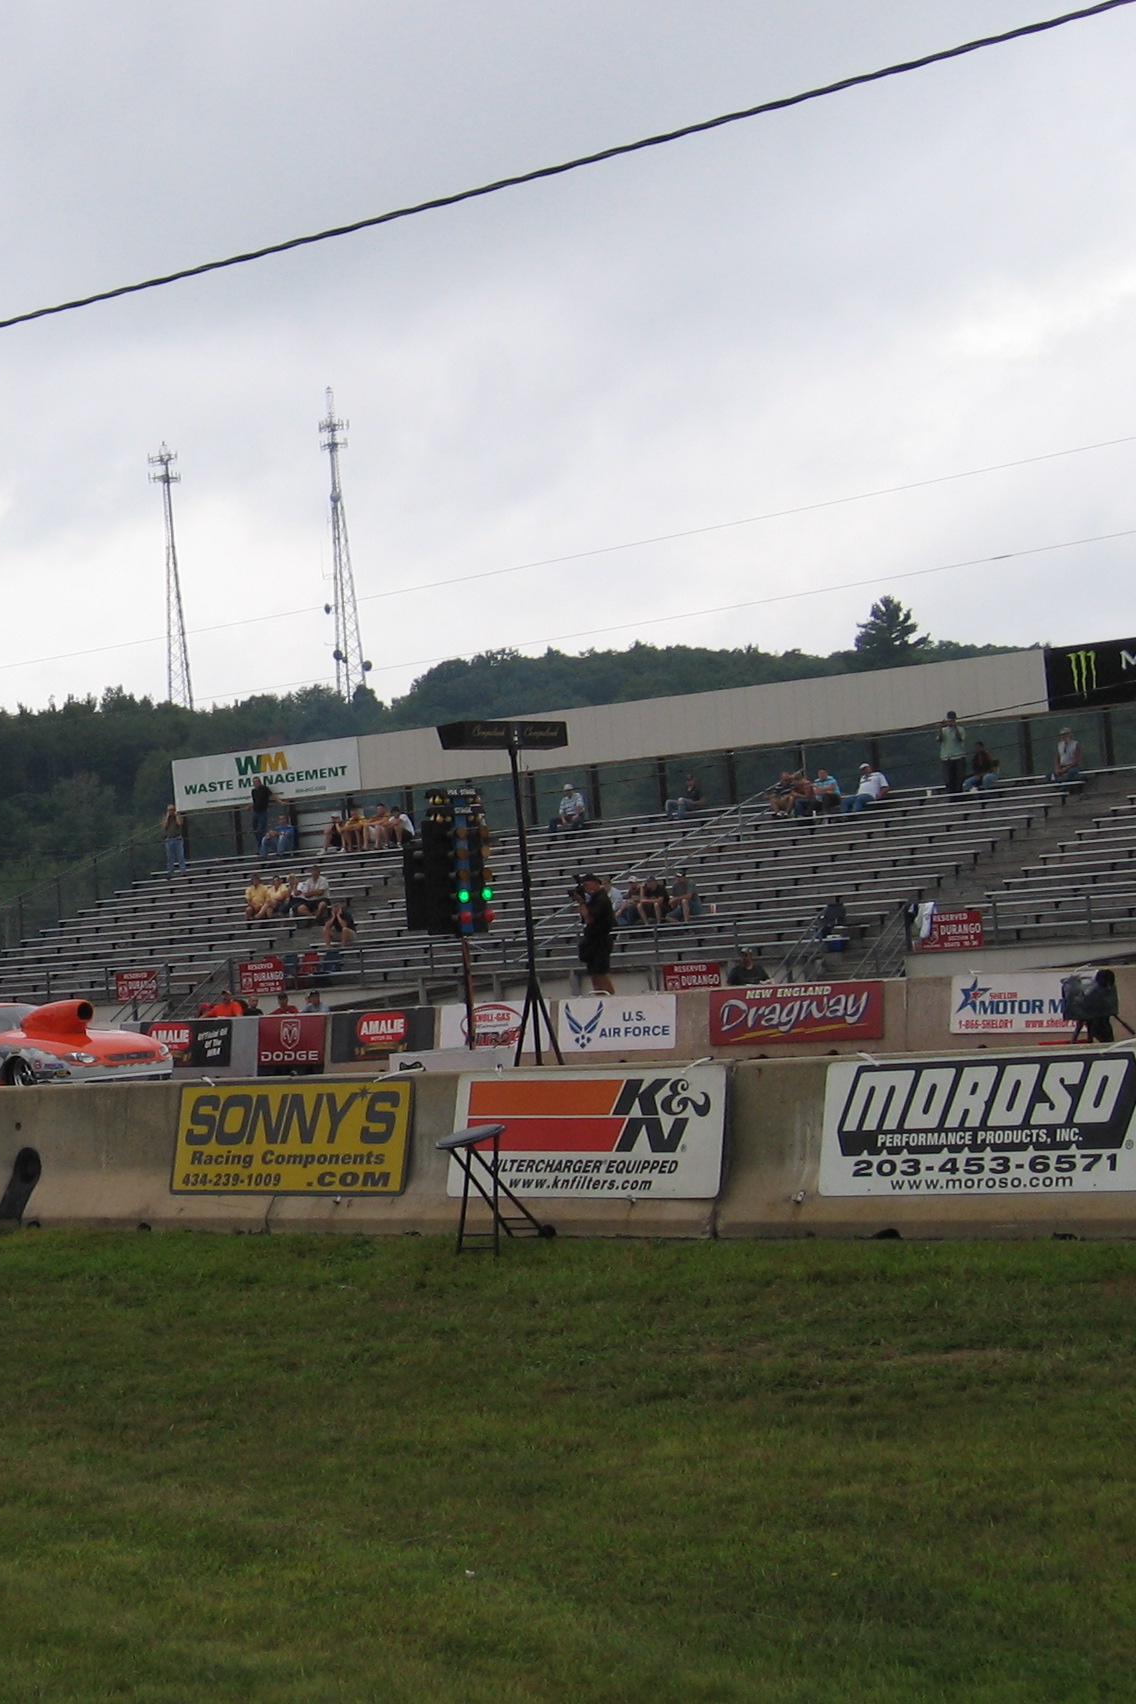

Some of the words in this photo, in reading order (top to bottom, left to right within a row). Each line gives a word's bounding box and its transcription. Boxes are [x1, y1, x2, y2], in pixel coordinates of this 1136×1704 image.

[184, 780, 234, 796] WASTE
[238, 765, 348, 790] MNAGEMENT
[932, 912, 968, 923] RESERVED
[940, 922, 982, 935] DURANGO
[247, 962, 274, 970] RESERVED
[673, 964, 708, 973] RESERVED
[253, 971, 284, 982] DURANGO
[680, 973, 721, 987] DURANGO
[745, 988, 773, 1000] NEW
[776, 985, 832, 998] ENGLAND
[989, 991, 1018, 1000] SHELOR
[720, 991, 869, 1034] Dragway
[978, 999, 1044, 1015] MOTOR
[622, 1010, 646, 1022] U.S.
[360, 1018, 405, 1036] AMALIE
[599, 1027, 621, 1039] AIR
[624, 1025, 670, 1038] FORCE
[151, 1029, 190, 1043] AMALIE
[261, 1050, 319, 1062] DODGE
[842, 1058, 1130, 1132] MOROSO
[185, 1087, 401, 1146] SONNY'S
[877, 1130, 973, 1148] PERFORMANCE
[977, 1128, 1051, 1145] PRODUCTS,
[1056, 1127, 1083, 1142] INC.
[191, 1150, 254, 1169] Racing
[261, 1150, 386, 1167] Components
[605, 1159, 679, 1175] EQUIPPED
[852, 1152, 1118, 1178] 203-453-6571
[182, 1172, 282, 1187] 434-239-1009
[306, 1170, 391, 1188] .COM
[509, 1175, 653, 1191] www.knfilters.com
[890, 1175, 1074, 1191] www.moroso.com
